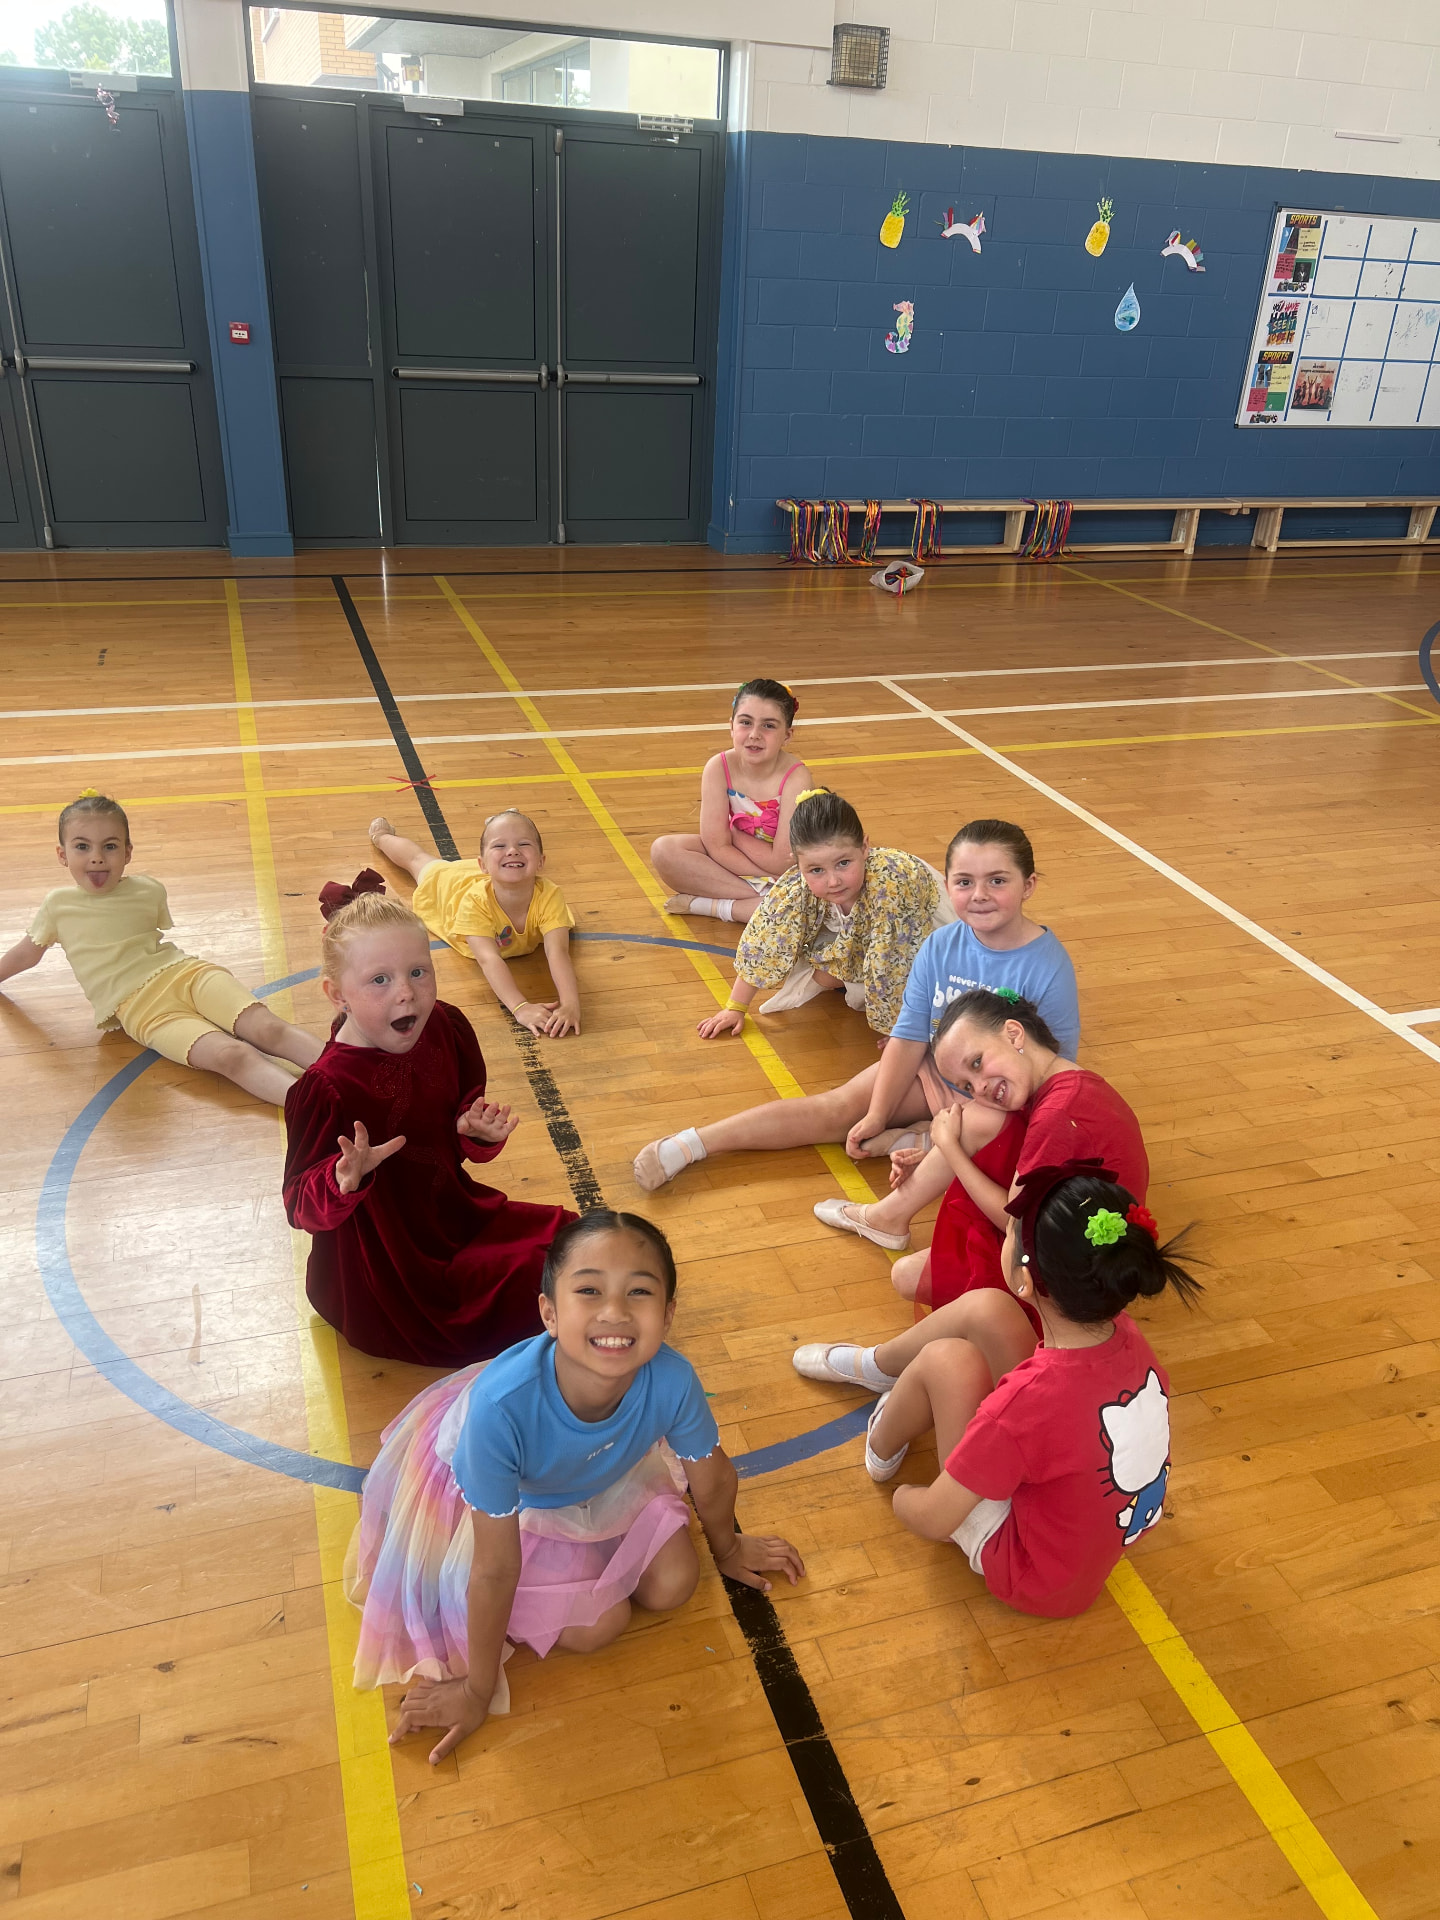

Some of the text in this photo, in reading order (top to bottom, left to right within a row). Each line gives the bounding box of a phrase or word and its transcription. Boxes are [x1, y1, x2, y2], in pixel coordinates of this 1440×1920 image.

[1290, 214, 1318, 225] SPORTS
[1273, 320, 1287, 331] SEE
[1263, 352, 1289, 360] SPORTS
